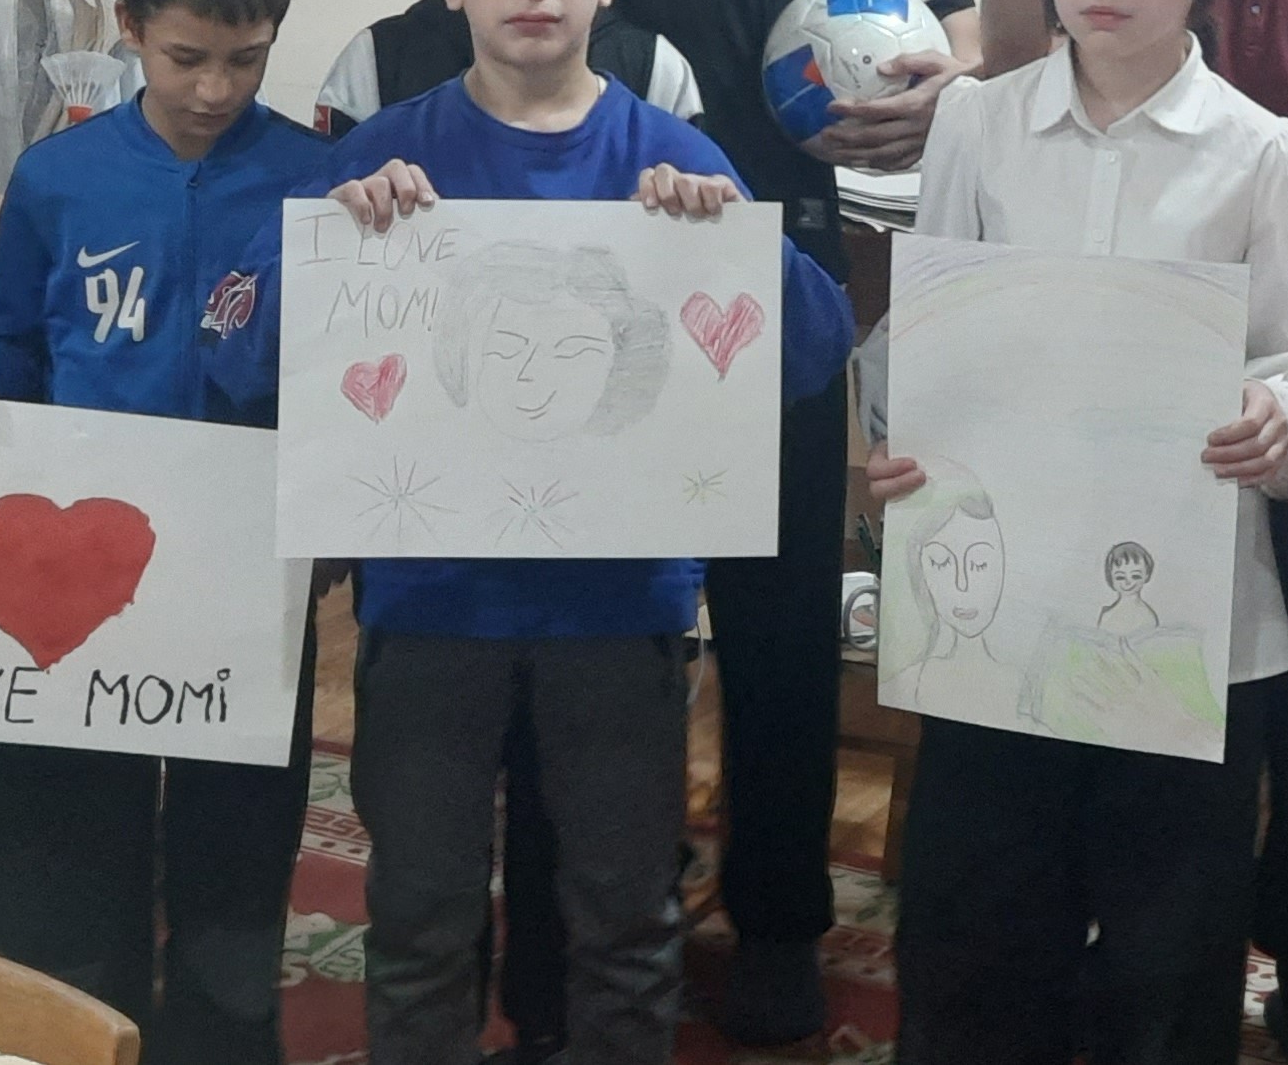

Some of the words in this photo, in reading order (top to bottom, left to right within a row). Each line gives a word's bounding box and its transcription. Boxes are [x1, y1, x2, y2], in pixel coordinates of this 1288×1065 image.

[294, 211, 349, 267] I
[357, 221, 462, 271] LOVE
[84, 265, 146, 344] 94
[324, 280, 440, 339] MOM!
